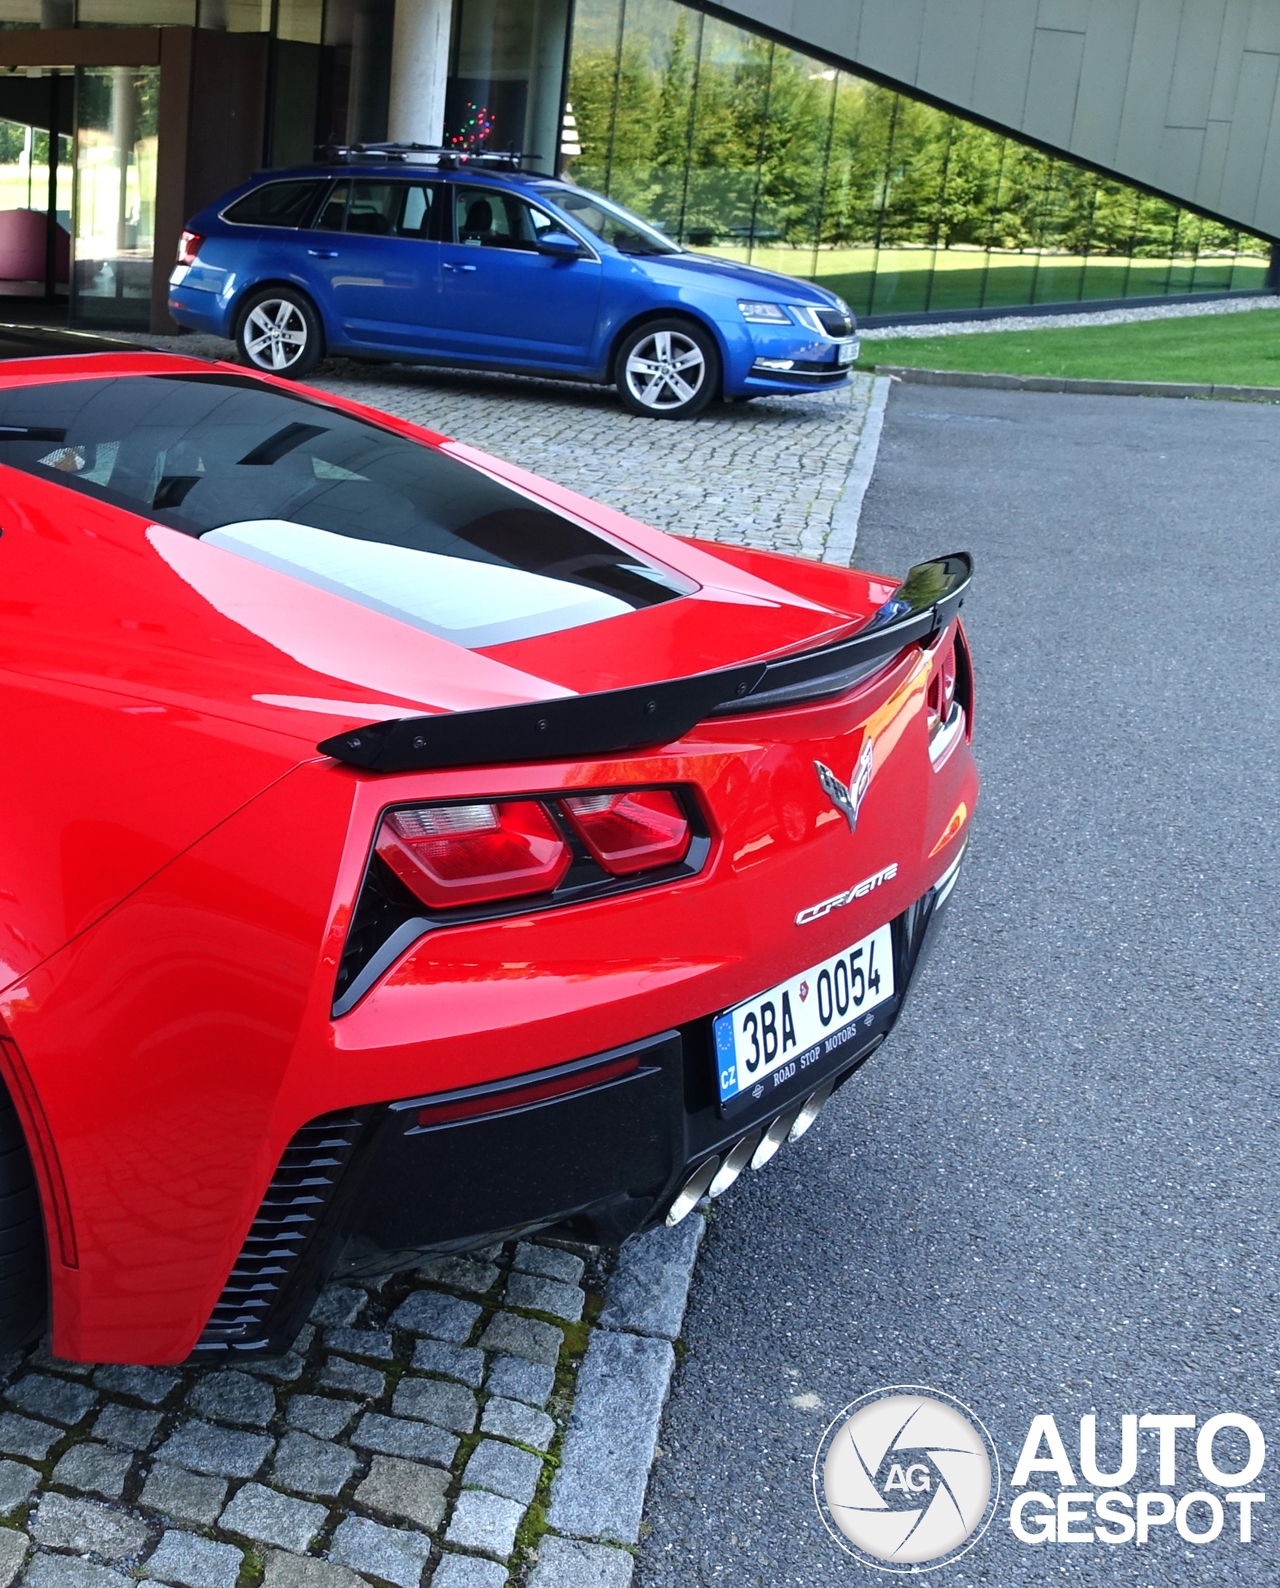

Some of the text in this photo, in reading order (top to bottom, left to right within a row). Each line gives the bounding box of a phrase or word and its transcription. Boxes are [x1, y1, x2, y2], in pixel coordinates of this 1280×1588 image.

[795, 863, 898, 925] CORVETTE
[742, 939, 881, 1073] 3BA 0054
[721, 1065, 736, 1090] CZ
[773, 1023, 857, 1087] ROAD STOP MOTORS
